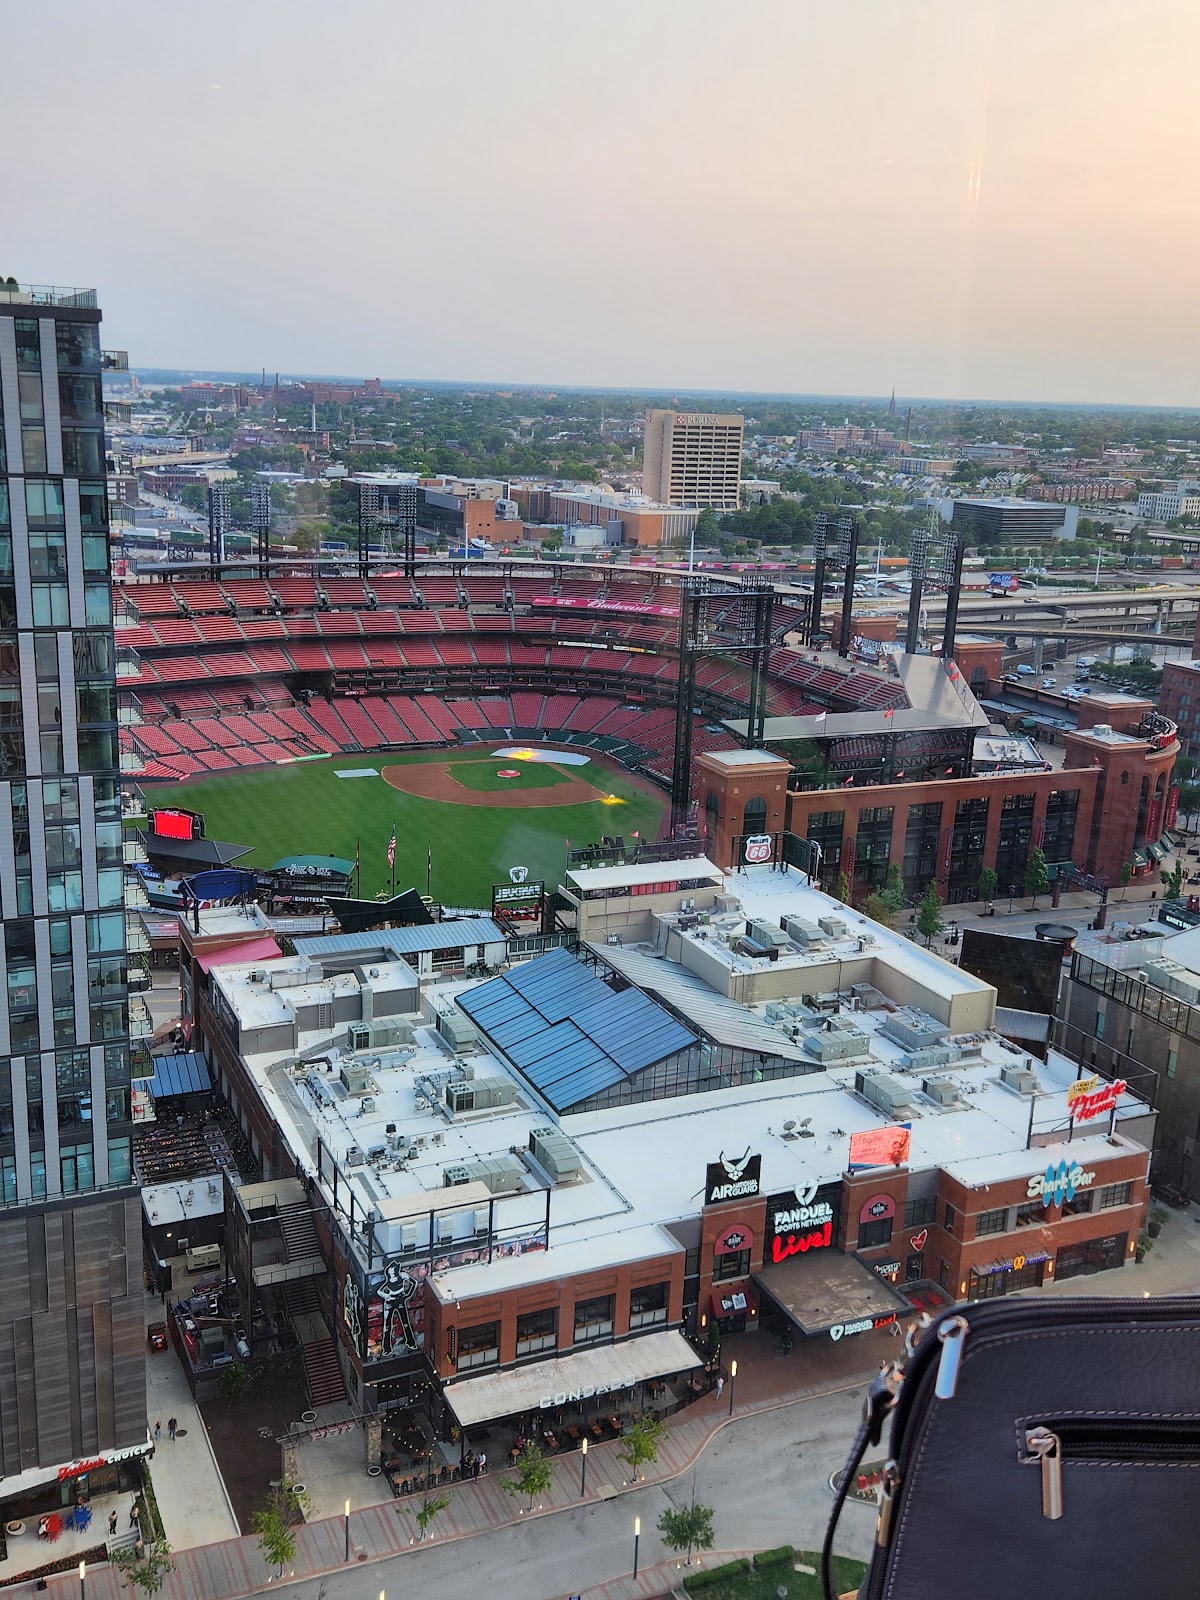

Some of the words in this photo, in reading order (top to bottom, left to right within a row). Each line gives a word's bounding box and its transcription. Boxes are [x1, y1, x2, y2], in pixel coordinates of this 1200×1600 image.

[687, 415, 720, 425] PURINA
[587, 598, 652, 612] Budweiser
[750, 846, 767, 859] 66
[144, 871, 160, 879] PLAZA
[1068, 1079, 1127, 1115] Prairie
[1075, 1098, 1116, 1123] Farms
[732, 1184, 758, 1197] GUARD
[733, 1179, 758, 1188] NATIONAL
[1027, 1172, 1068, 1197] Shark
[1068, 1166, 1096, 1187] Bar
[710, 1183, 733, 1201] AIR
[774, 1202, 834, 1225] FANDUEL
[775, 1222, 800, 1234] SPORTS
[801, 1214, 832, 1228] NETWORK
[772, 1221, 833, 1263] Live!
[874, 1312, 896, 1329] Live!
[540, 1374, 635, 1409] CONDADO
[58, 1457, 105, 1482] Fielder's
[107, 1446, 147, 1464] CHOICE
